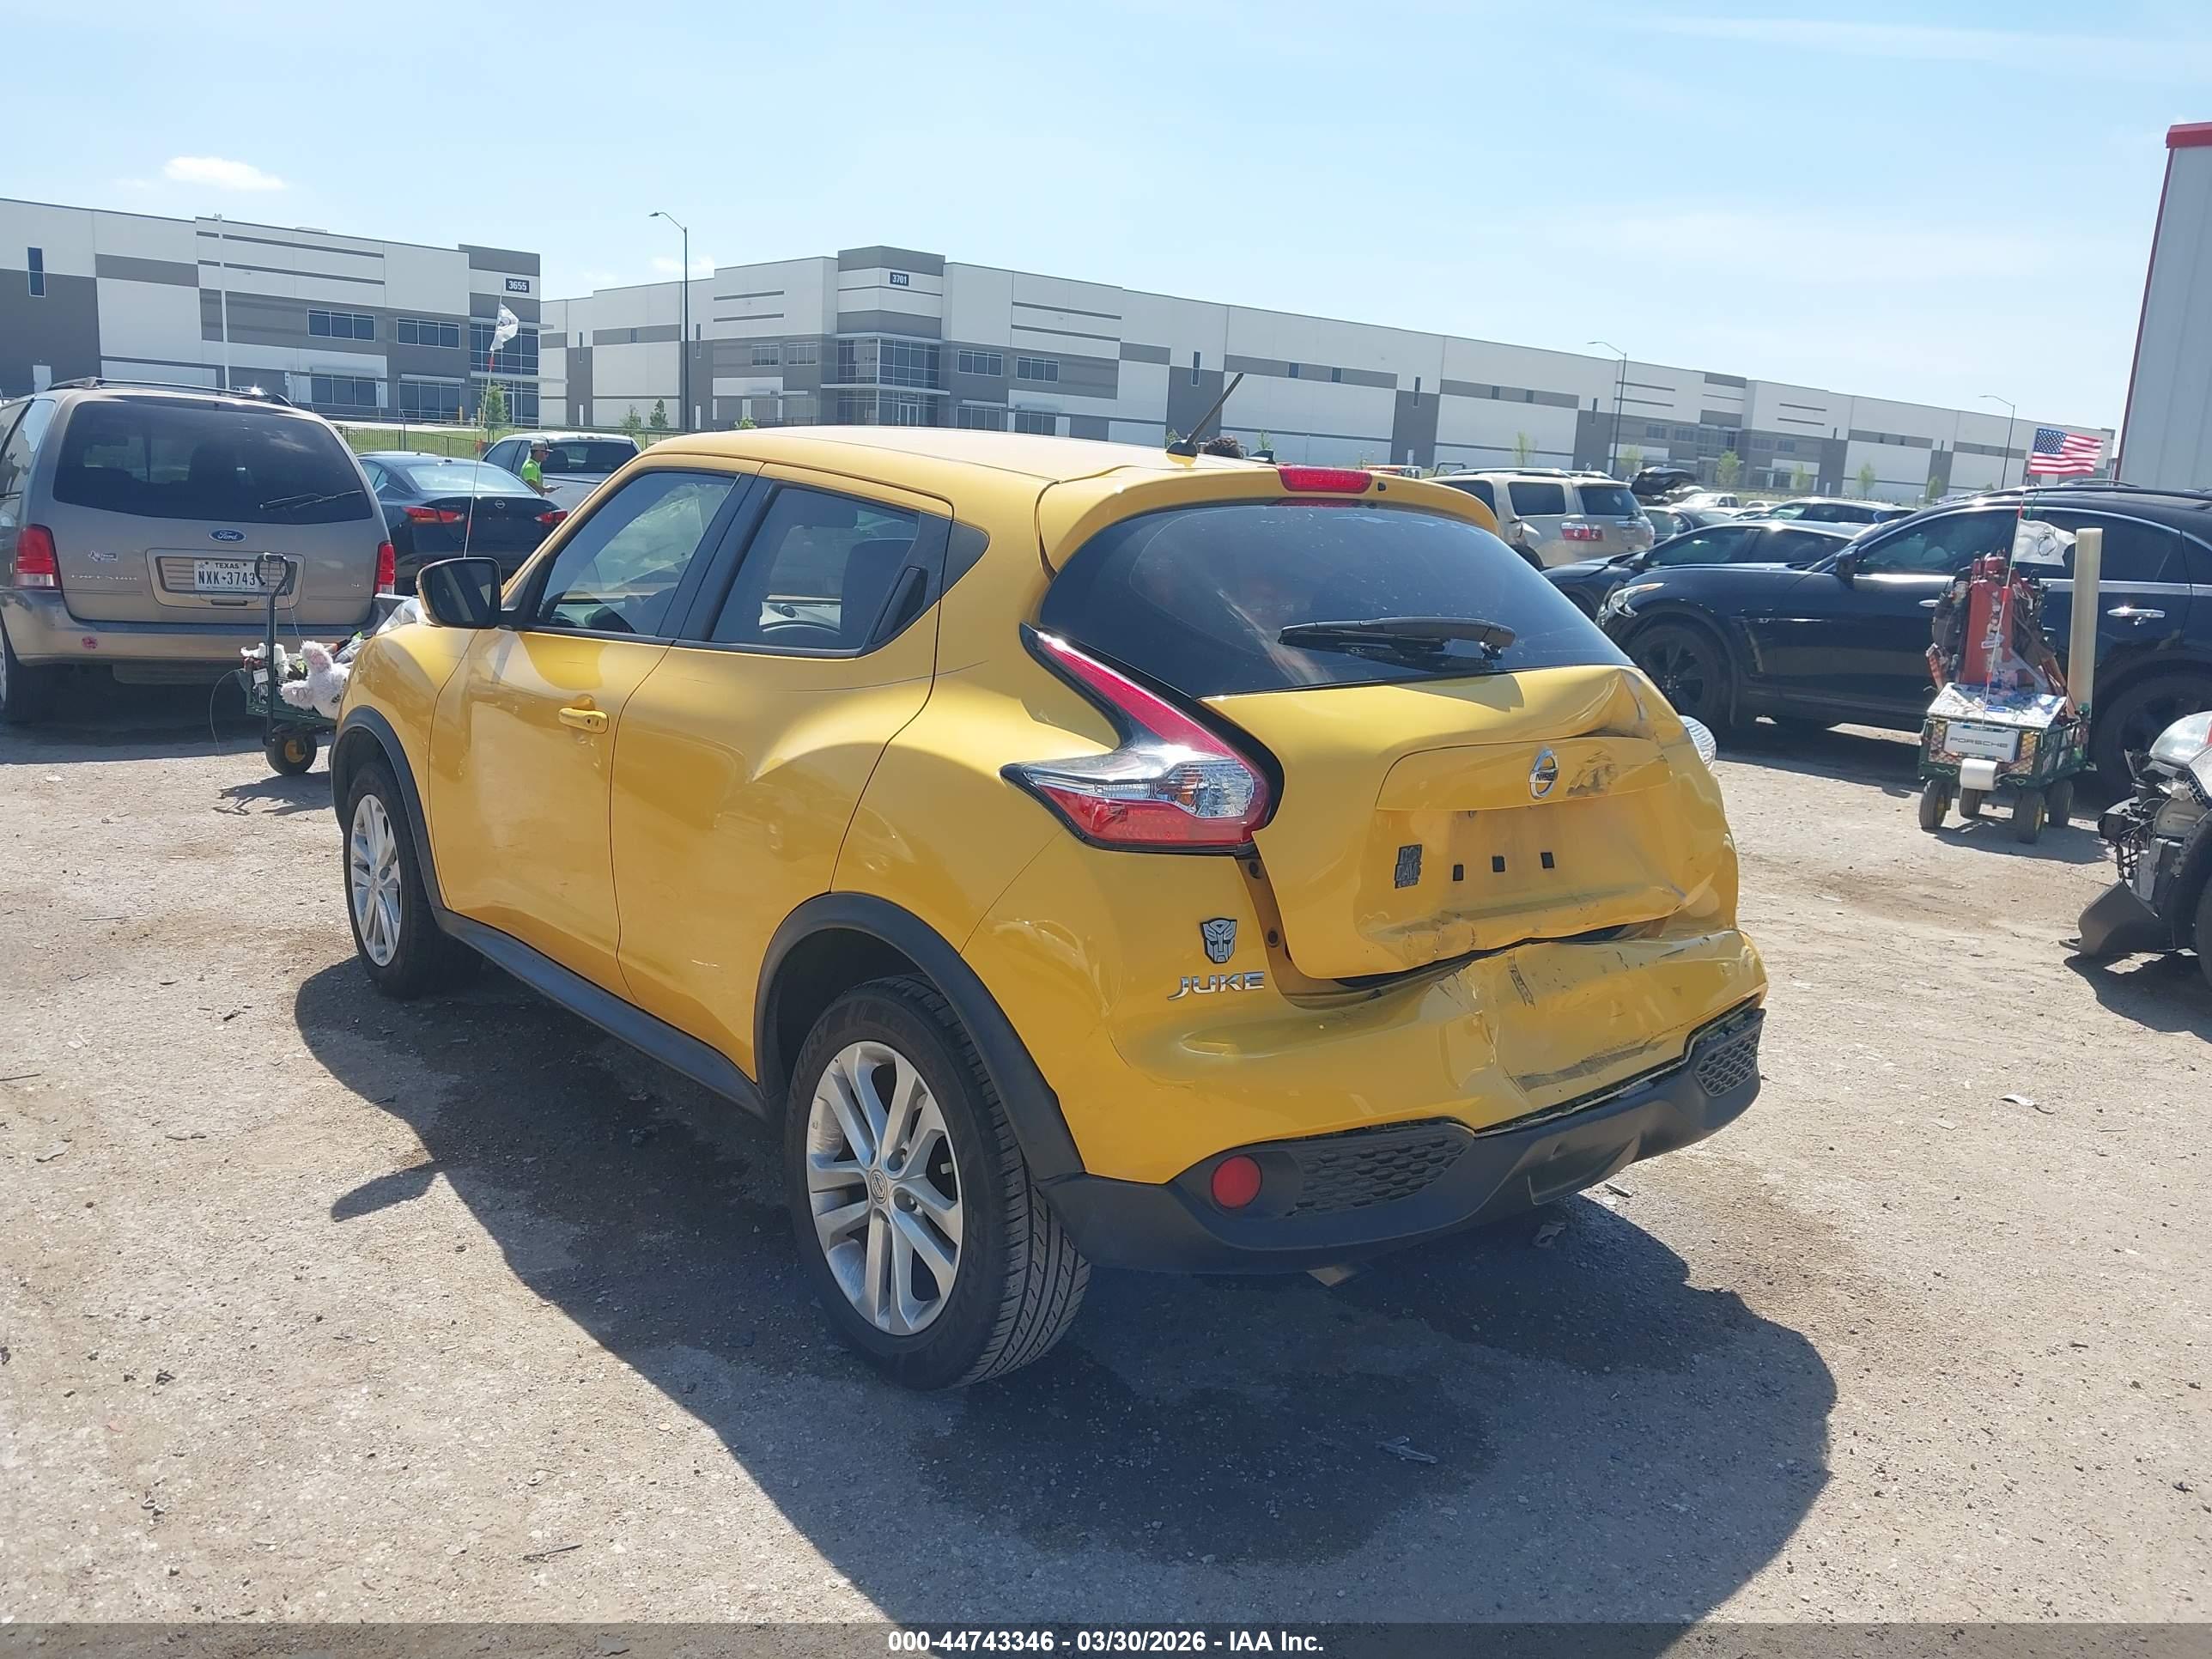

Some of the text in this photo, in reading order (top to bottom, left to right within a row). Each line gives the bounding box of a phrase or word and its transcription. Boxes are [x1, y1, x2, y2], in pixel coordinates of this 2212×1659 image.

[893, 274, 907, 284] 3701
[508, 280, 527, 290] 3655
[217, 532, 238, 540] Ford
[1950, 737, 2008, 748] PORSCHE
[1167, 971, 1265, 1000] JUKE
